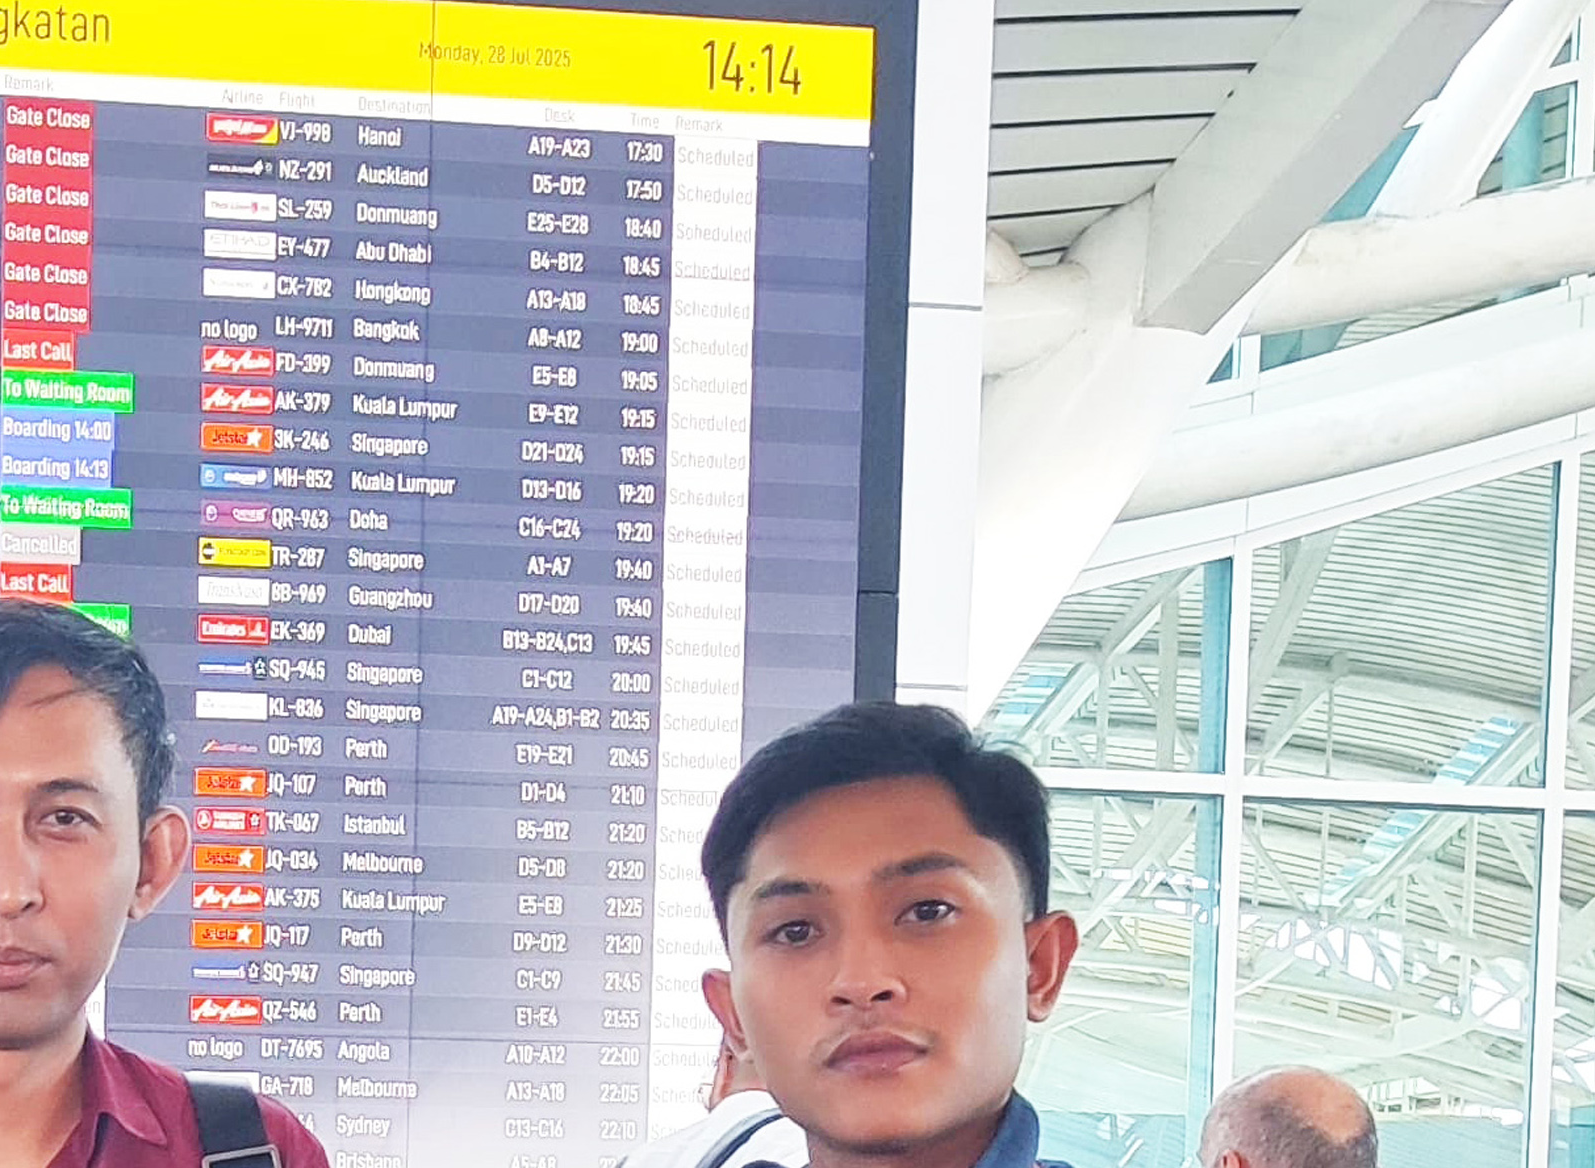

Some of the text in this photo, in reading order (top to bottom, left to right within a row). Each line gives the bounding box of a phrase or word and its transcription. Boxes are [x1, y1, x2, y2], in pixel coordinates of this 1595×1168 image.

[419, 41, 571, 68] Monday, 28 Jul 2025
[703, 40, 802, 95] 14:14
[7, 106, 43, 126] Gate
[47, 109, 90, 128] Close
[279, 121, 661, 161] VJ-998 Hanoi 17:30
[6, 145, 42, 164] Gate
[46, 146, 89, 167] Close
[280, 160, 661, 200] NZ-291 Auckland 17:50
[6, 184, 42, 204] Gate
[45, 185, 88, 206] Close
[278, 198, 661, 238] SL-259 Donmuang 18:40
[5, 222, 41, 244] Gate
[45, 225, 88, 244] Close
[278, 237, 660, 276] EY-477 Abu Dhabi 18:45
[5, 262, 41, 282] Gate
[44, 264, 87, 284] Close
[278, 276, 659, 314] CX-782 Hongkong 18:45
[2, 301, 41, 322] Gate
[44, 303, 87, 322] Close
[276, 316, 657, 352] LH-9711 Bangkok 19:00
[3, 339, 37, 360] Last
[41, 340, 73, 361] Call
[276, 353, 657, 390] FD-399 Donmuang 19:05
[4, 377, 21, 397] To
[24, 378, 83, 403] Waiting
[86, 381, 130, 403] Room
[353, 394, 457, 421] Kuala Lumpur
[3, 417, 71, 441] Boarding
[75, 420, 111, 440] 14:00
[350, 433, 428, 456] Singapore
[2, 456, 70, 480] Boarding
[75, 459, 108, 479] 14:13
[352, 472, 455, 496] Kuala Lumpur
[2, 494, 19, 514] To
[23, 495, 81, 520] Waiting
[84, 499, 129, 520] Room
[350, 510, 388, 529] Doha
[1, 533, 77, 555] Cancelled
[348, 548, 423, 571] Singapore
[1, 574, 34, 594] Last
[38, 575, 69, 595] Call
[349, 586, 432, 609] Guangzhou
[349, 624, 390, 644] Dubai
[347, 662, 422, 685] Singapore
[346, 699, 421, 723] Singapore
[346, 739, 386, 757] Perth
[346, 776, 385, 796] Perth
[345, 815, 405, 834] Istanbul
[343, 853, 422, 873] Melbourne
[343, 890, 445, 914] Kuala Lumpur
[342, 928, 381, 946] Perth
[341, 966, 414, 987] Singapore
[341, 1003, 380, 1021] Perth
[338, 1041, 389, 1062] Angola
[339, 1077, 415, 1095] Melbourne
[337, 1115, 390, 1138] Sydney
